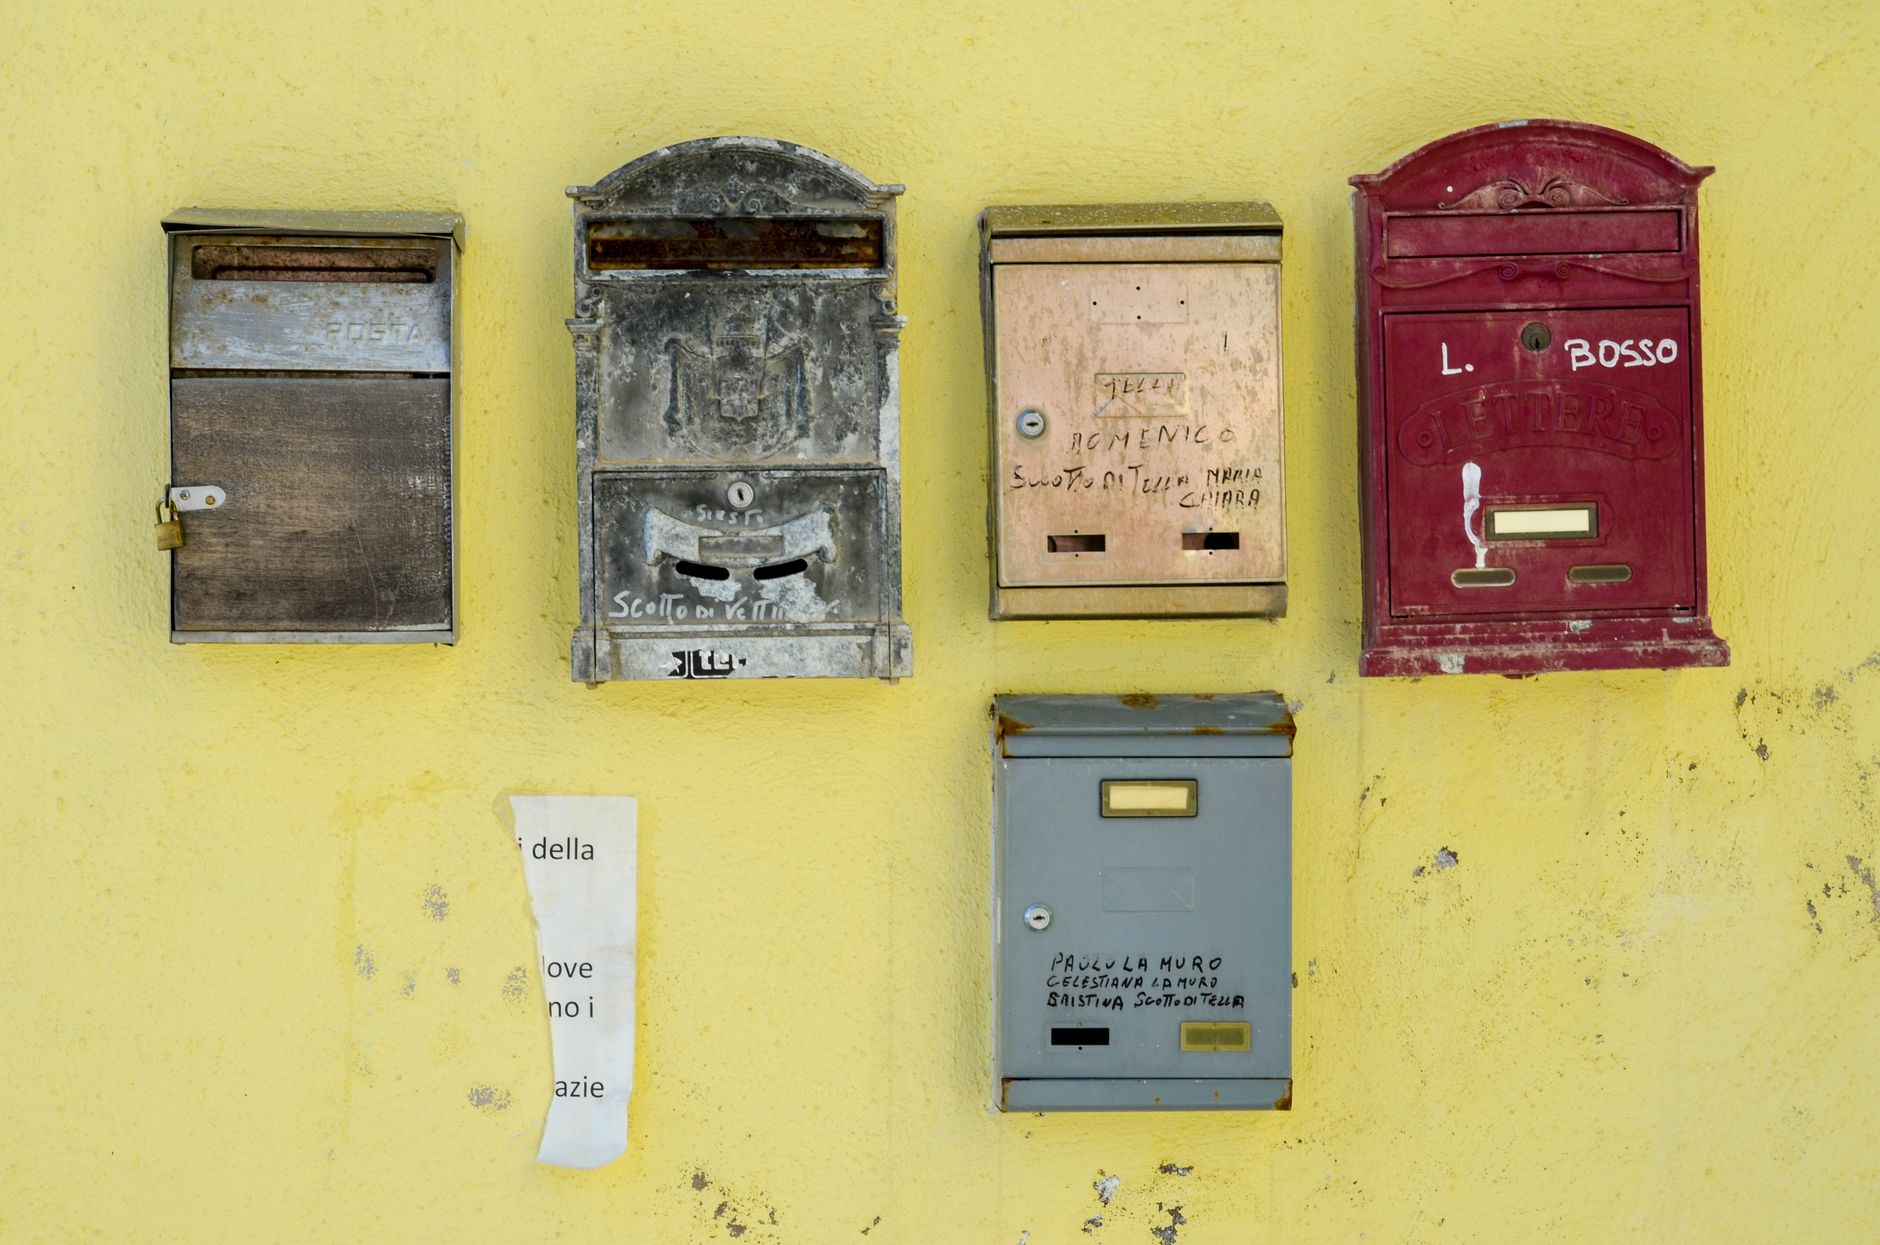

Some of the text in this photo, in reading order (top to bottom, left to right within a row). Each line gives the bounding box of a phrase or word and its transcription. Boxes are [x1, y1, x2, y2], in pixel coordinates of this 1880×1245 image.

[326, 322, 424, 345] POSTA
[1440, 338, 1678, 375] L. BOSSO
[1429, 391, 1648, 450] LETTERE
[532, 836, 594, 860] della
[1160, 955, 1222, 973] MURO
[548, 1001, 579, 1018] no
[555, 1076, 605, 1098] azie
